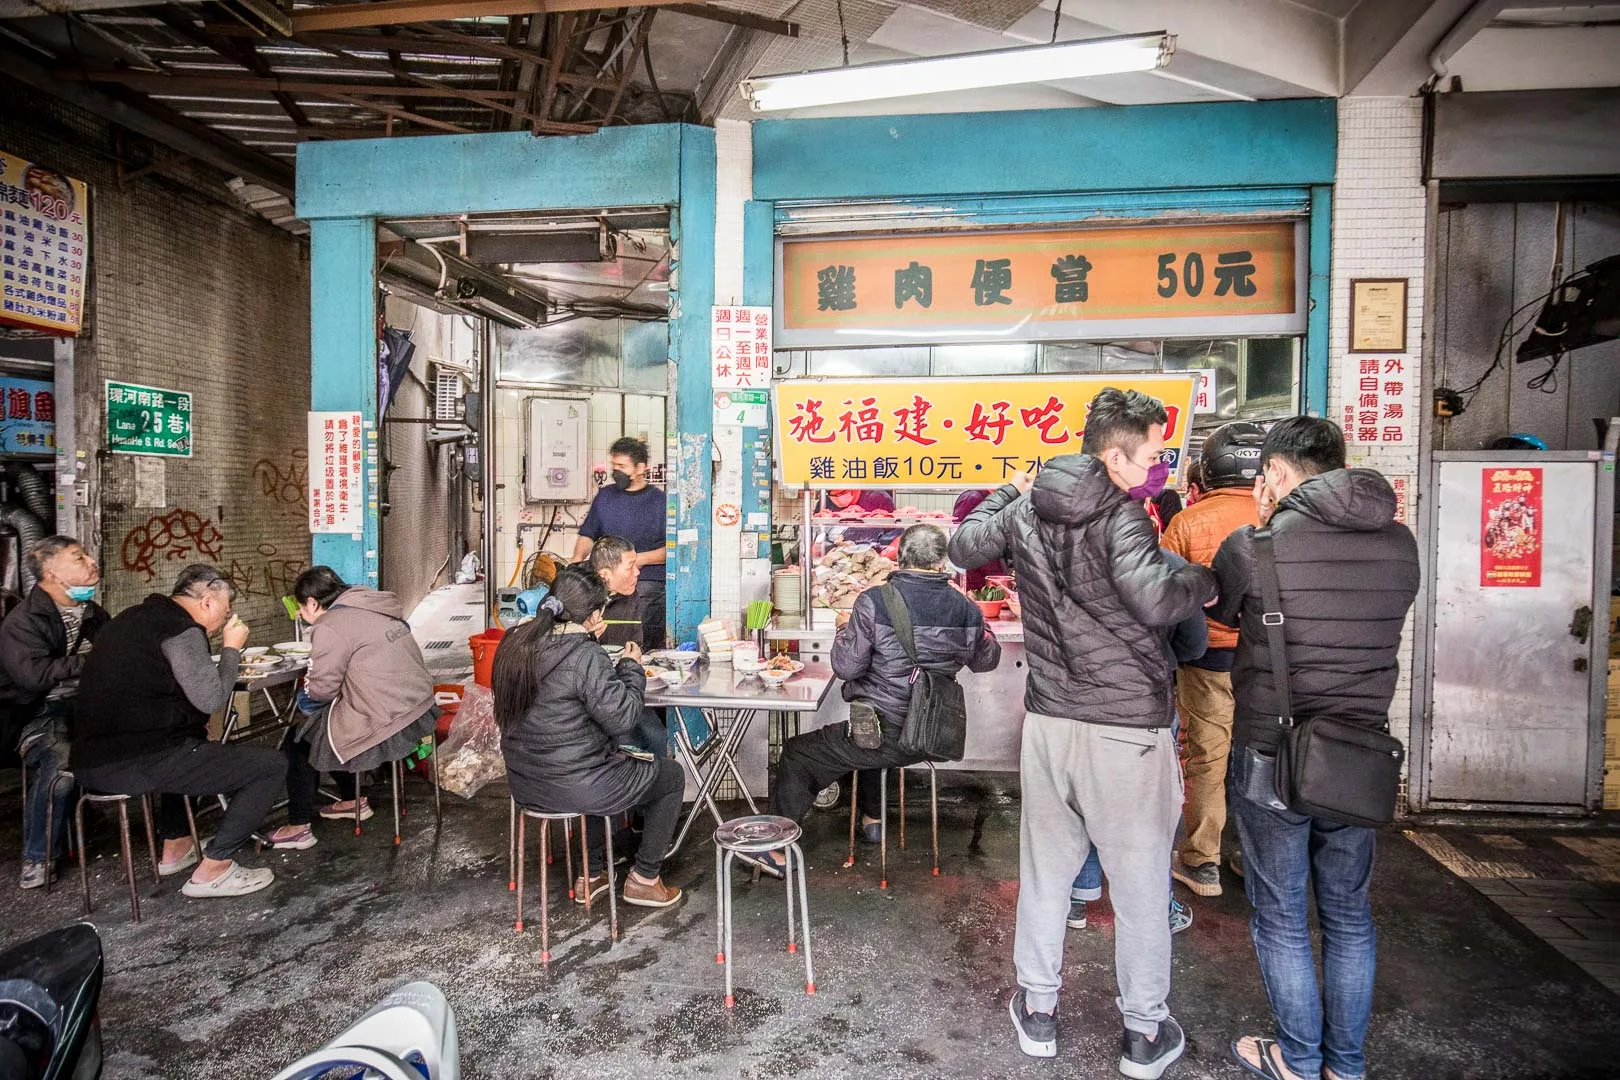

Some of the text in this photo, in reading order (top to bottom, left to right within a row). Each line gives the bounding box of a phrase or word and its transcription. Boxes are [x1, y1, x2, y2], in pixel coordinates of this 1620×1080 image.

[71, 231, 83, 243] 30
[71, 246, 83, 256] 30
[4, 240, 82, 270] 麻油下水 30
[70, 274, 81, 284] 30
[70, 288, 80, 297] 15
[817, 251, 1258, 312] 雞肉便當 50元
[716, 309, 732, 378] 週日公休
[735, 309, 751, 386] 週一至週六
[0, 386, 55, 421] 旗魚
[109, 387, 190, 411] 環河南路一段
[1358, 359, 1379, 442] 請自備容器
[1383, 358, 1405, 442] 外帶湯品
[116, 419, 136, 430] Lane
[736, 410, 746, 424] 4
[324, 419, 335, 525] 請勿將垃圾置於地面
